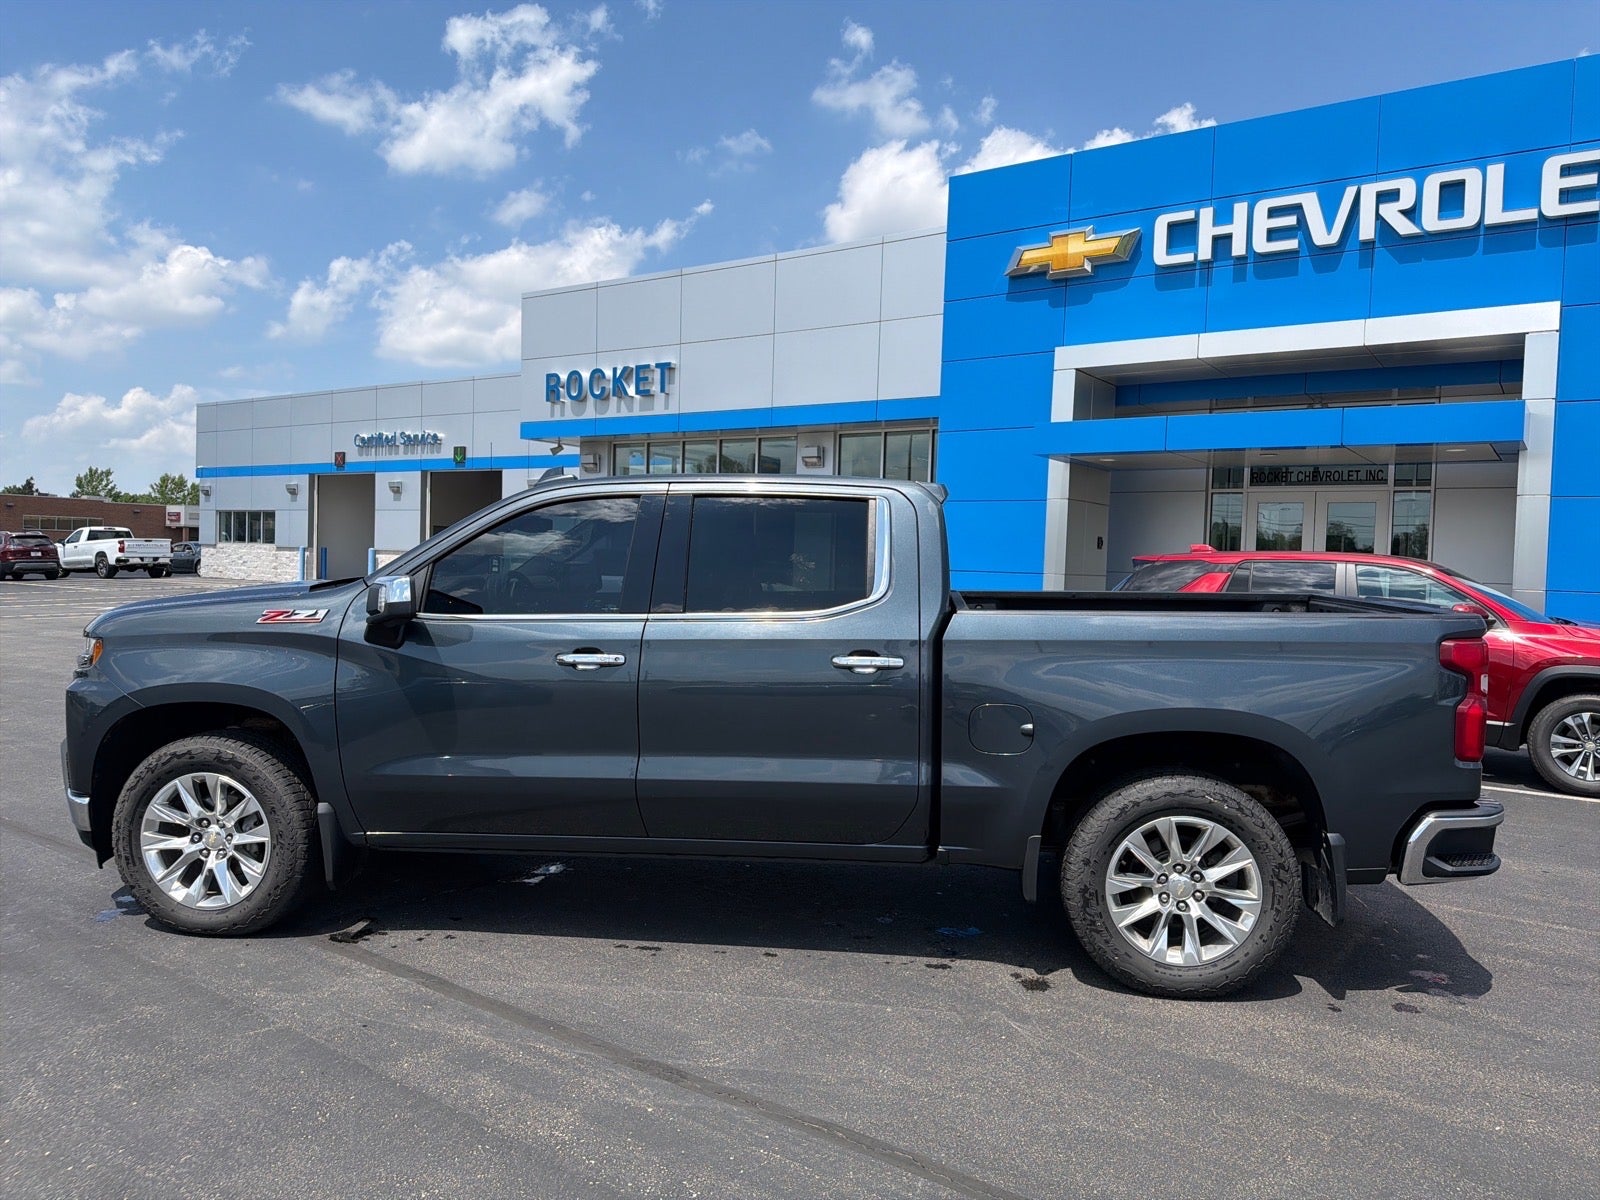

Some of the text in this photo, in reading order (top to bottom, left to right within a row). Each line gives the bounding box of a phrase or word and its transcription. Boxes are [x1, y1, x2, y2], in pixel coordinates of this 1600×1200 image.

[545, 361, 675, 404] ROCKET
[353, 430, 442, 448] Certified Service
[1252, 471, 1294, 483] ROCKET
[256, 609, 330, 624] Z71
